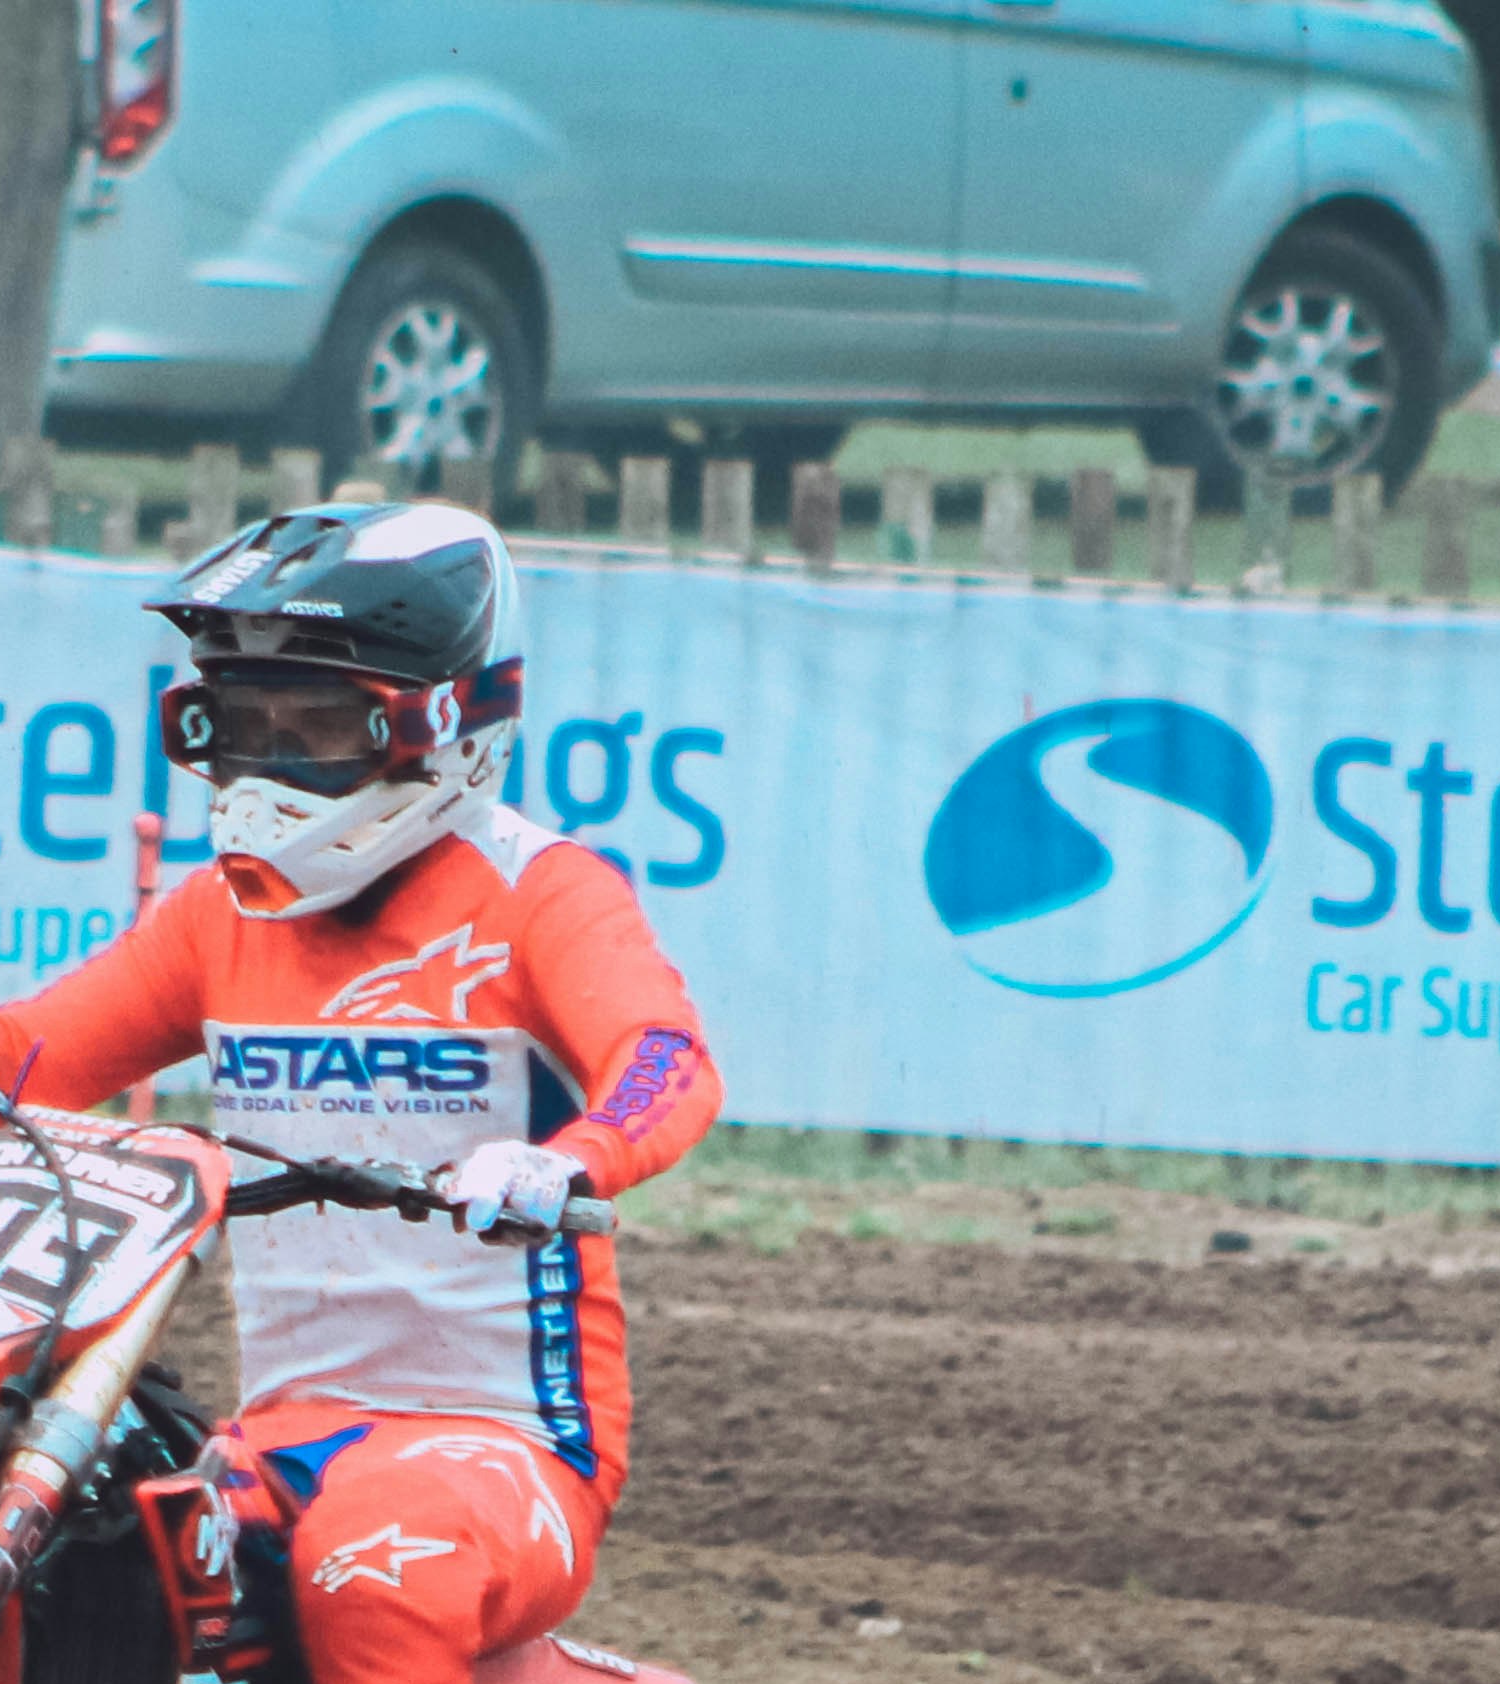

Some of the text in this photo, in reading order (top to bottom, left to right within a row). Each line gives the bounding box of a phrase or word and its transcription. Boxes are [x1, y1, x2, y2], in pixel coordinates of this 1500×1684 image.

[1305, 962, 1404, 1035] Car
[213, 1035, 490, 1092] ASTARS
[242, 1097, 300, 1112] GOAL
[320, 1098, 375, 1114] ONE
[384, 1098, 490, 1114] VISION
